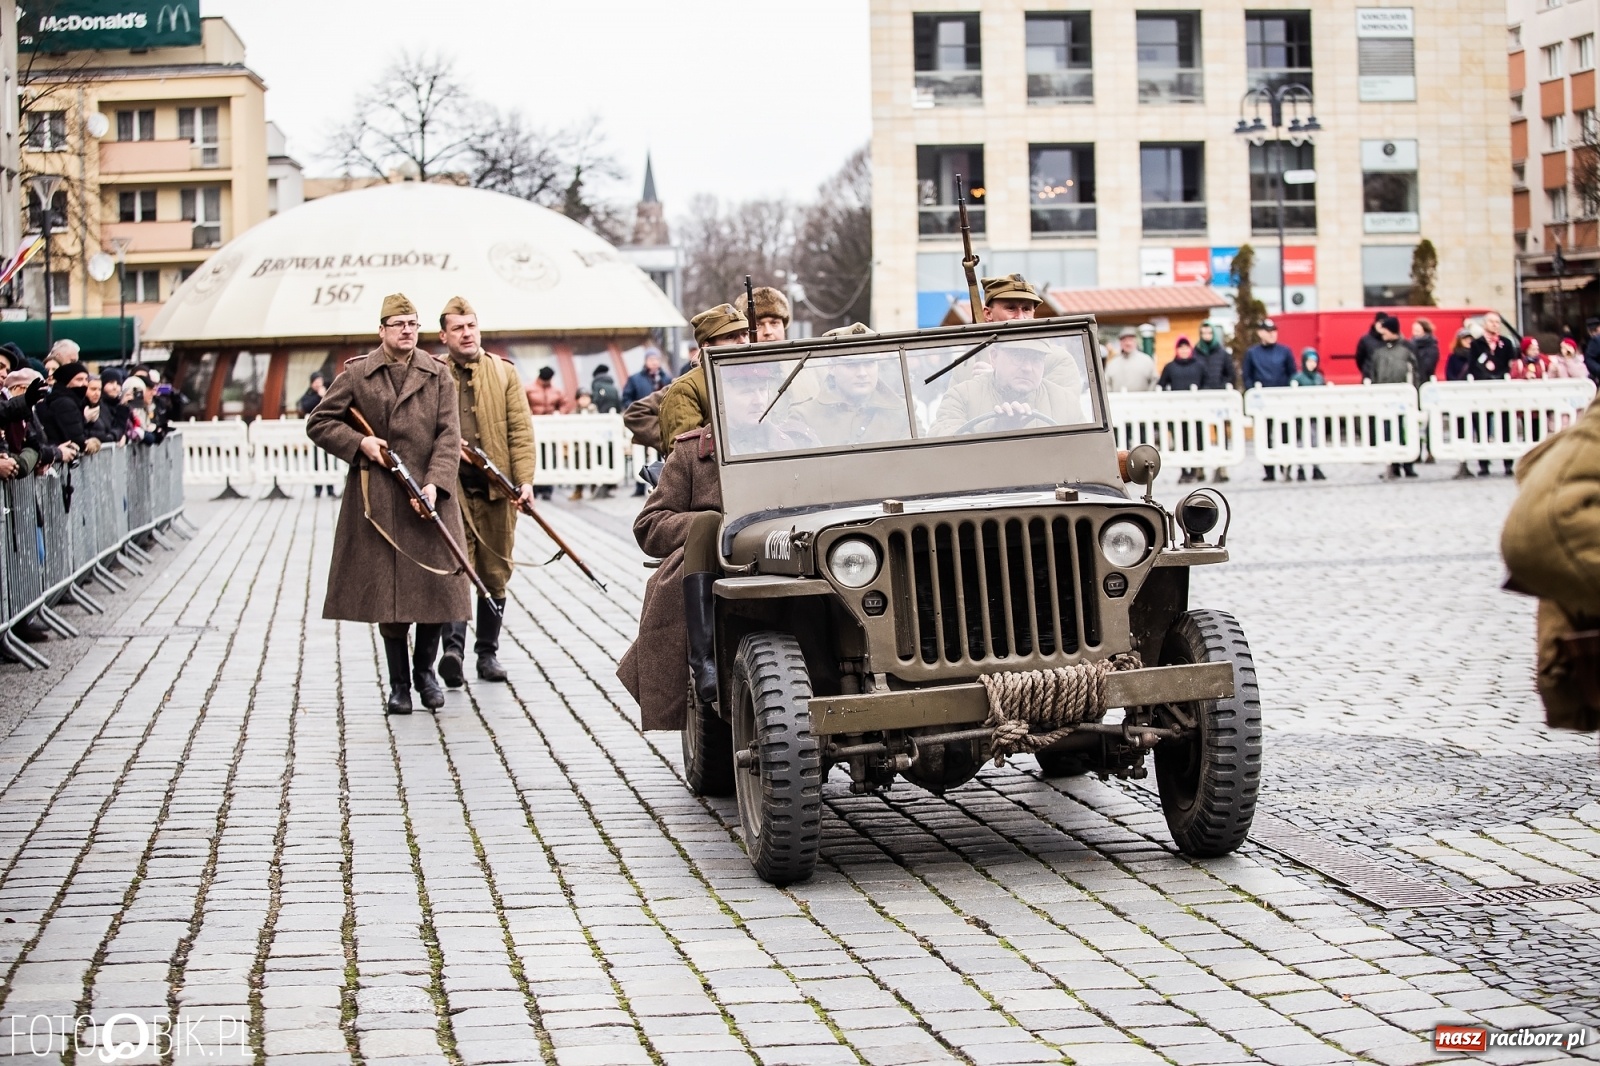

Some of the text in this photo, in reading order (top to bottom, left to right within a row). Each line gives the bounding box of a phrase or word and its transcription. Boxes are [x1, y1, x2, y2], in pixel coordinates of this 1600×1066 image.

[39, 12, 148, 32] McDonald's
[251, 250, 459, 278] BROWAR RACIBÓRZ
[312, 284, 364, 305] 1567
